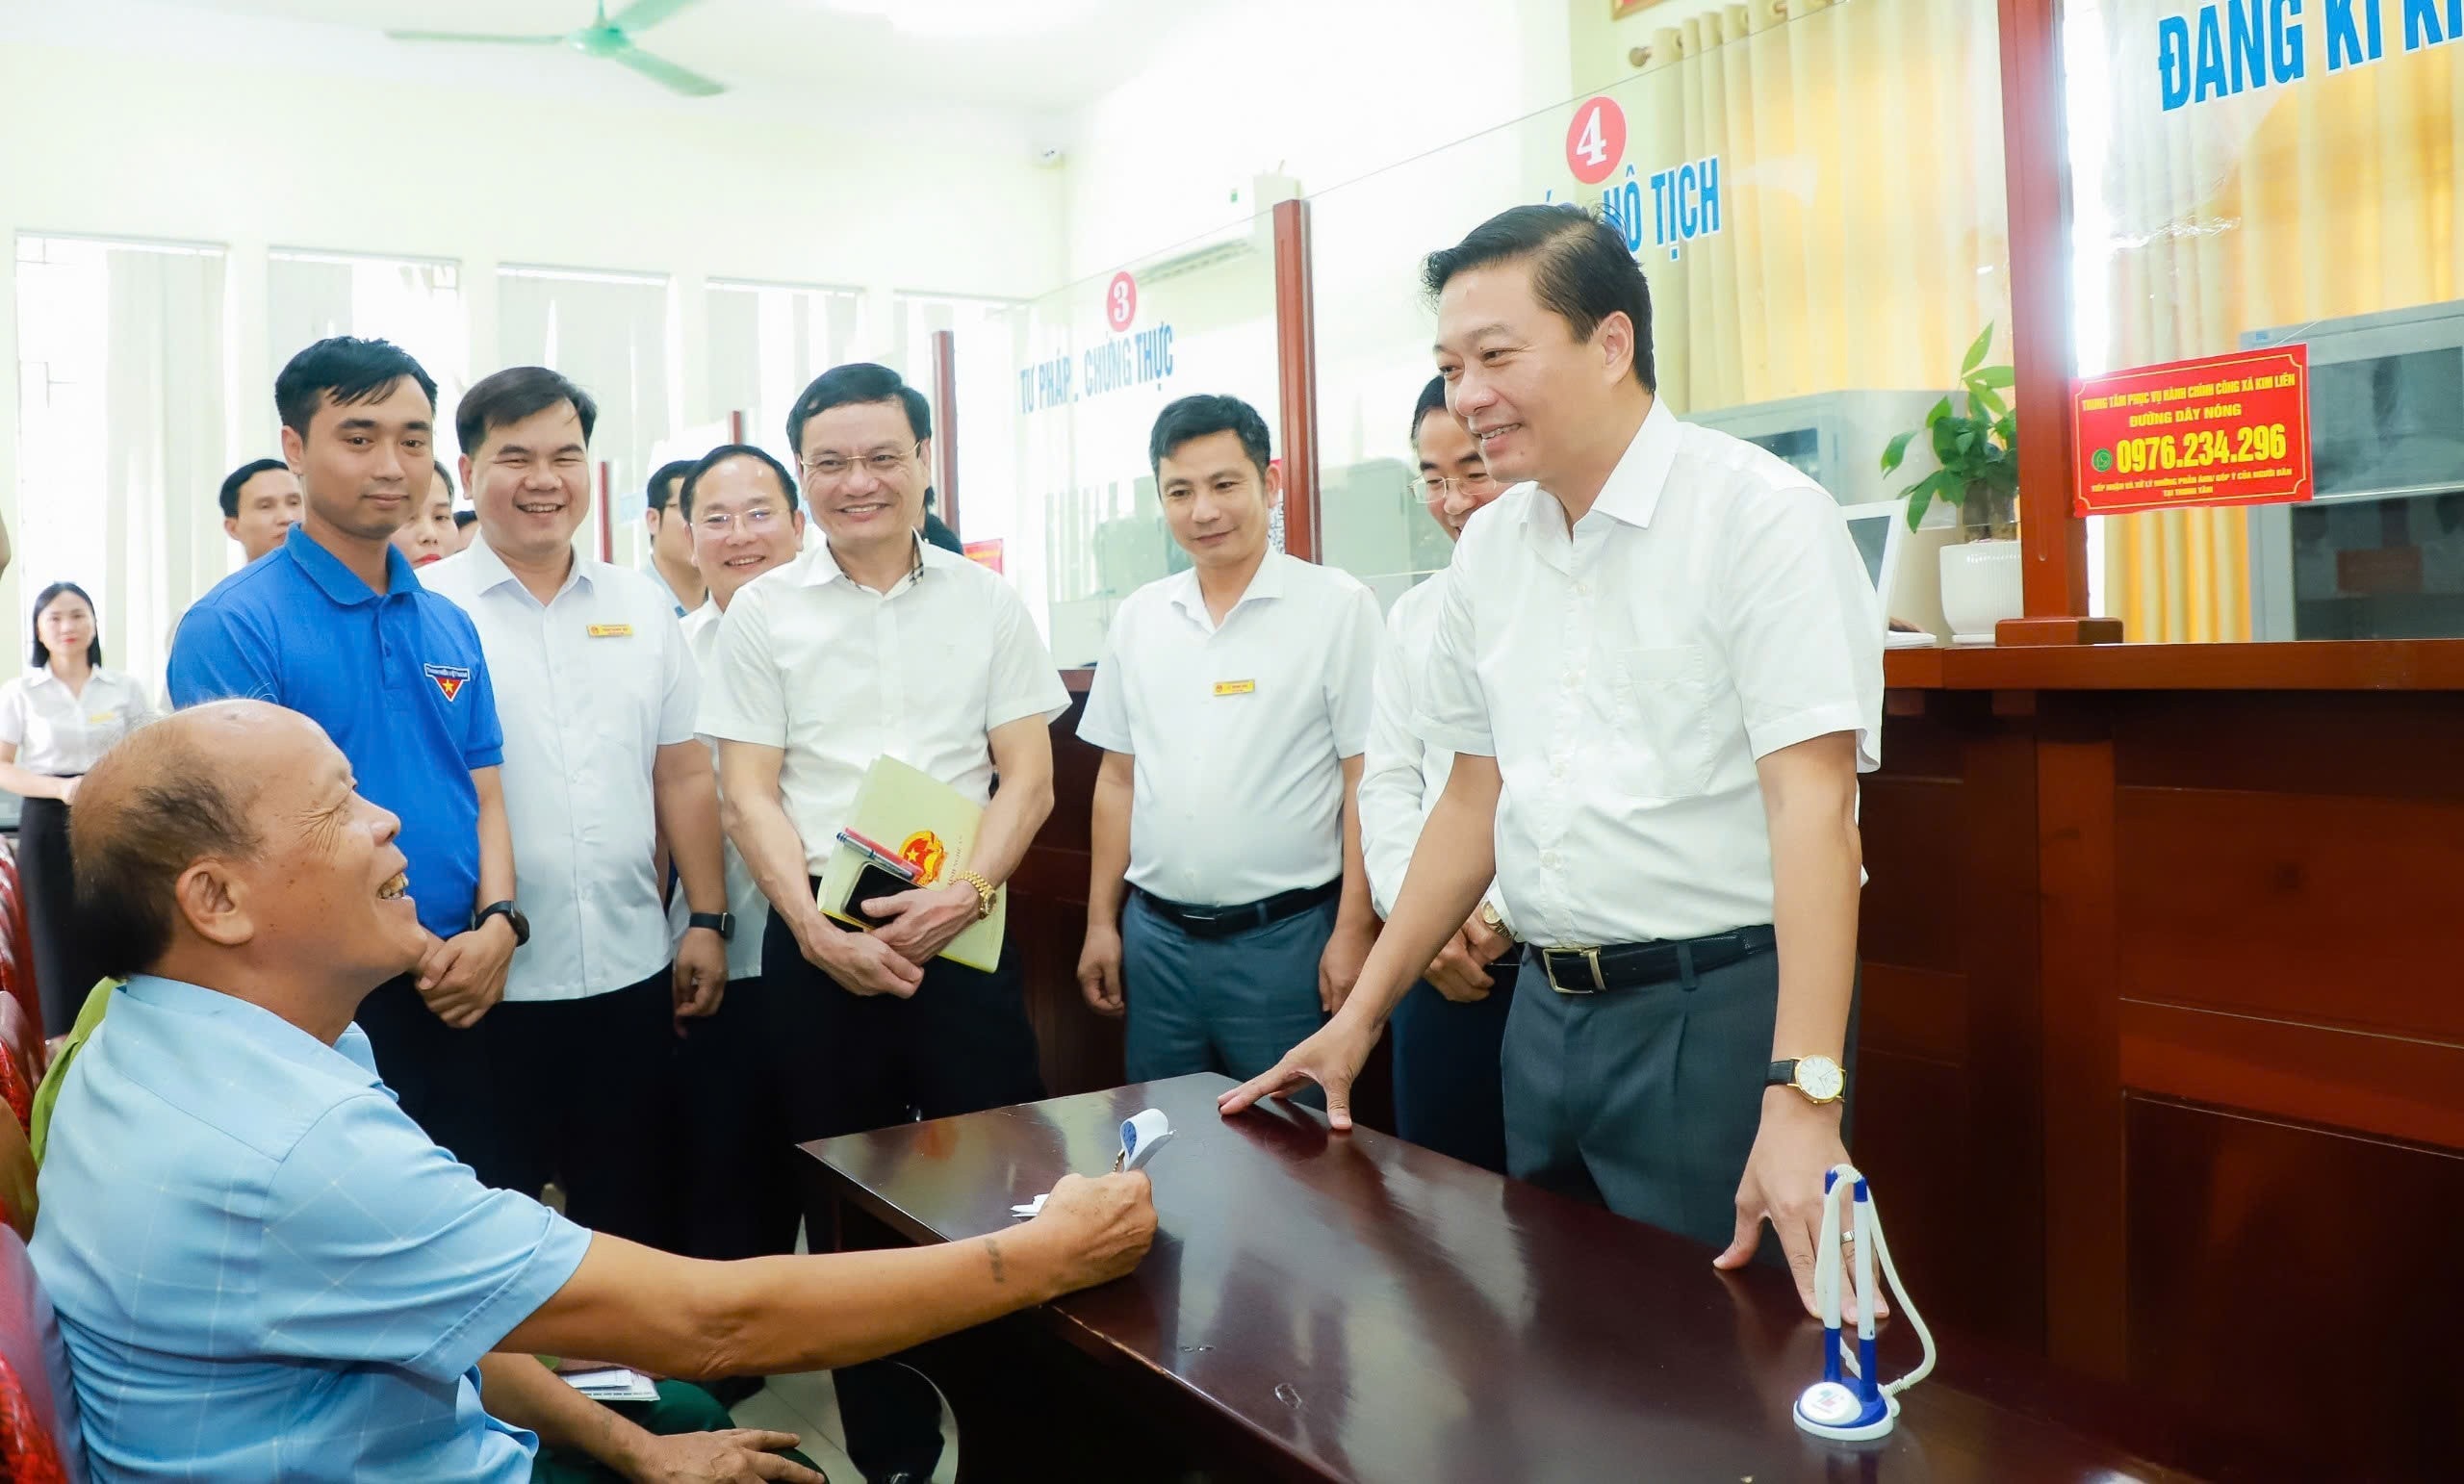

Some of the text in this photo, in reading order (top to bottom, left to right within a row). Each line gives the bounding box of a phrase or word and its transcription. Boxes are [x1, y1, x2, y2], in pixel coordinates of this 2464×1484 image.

[1576, 106, 1607, 166] 4
[1650, 156, 1720, 261] TỊCH
[1113, 280, 1130, 322] 3
[1019, 362, 1036, 414] TƯ
[1134, 320, 1174, 392] THỰC
[2109, 394, 2127, 408] TÂM
[2127, 392, 2149, 407] PHỤC
[2150, 390, 2163, 404] VỤ
[2163, 386, 2187, 400] HÀNH
[2187, 381, 2214, 398] CHÍNH
[2215, 379, 2240, 395] CÔNG
[2241, 376, 2254, 392] XÃ
[2254, 375, 2273, 390] KIM
[2274, 371, 2296, 388] LIÊN
[2129, 402, 2242, 427] ĐƯỜNG DÂY NÓNG
[2117, 422, 2287, 474] 0976.234.296
